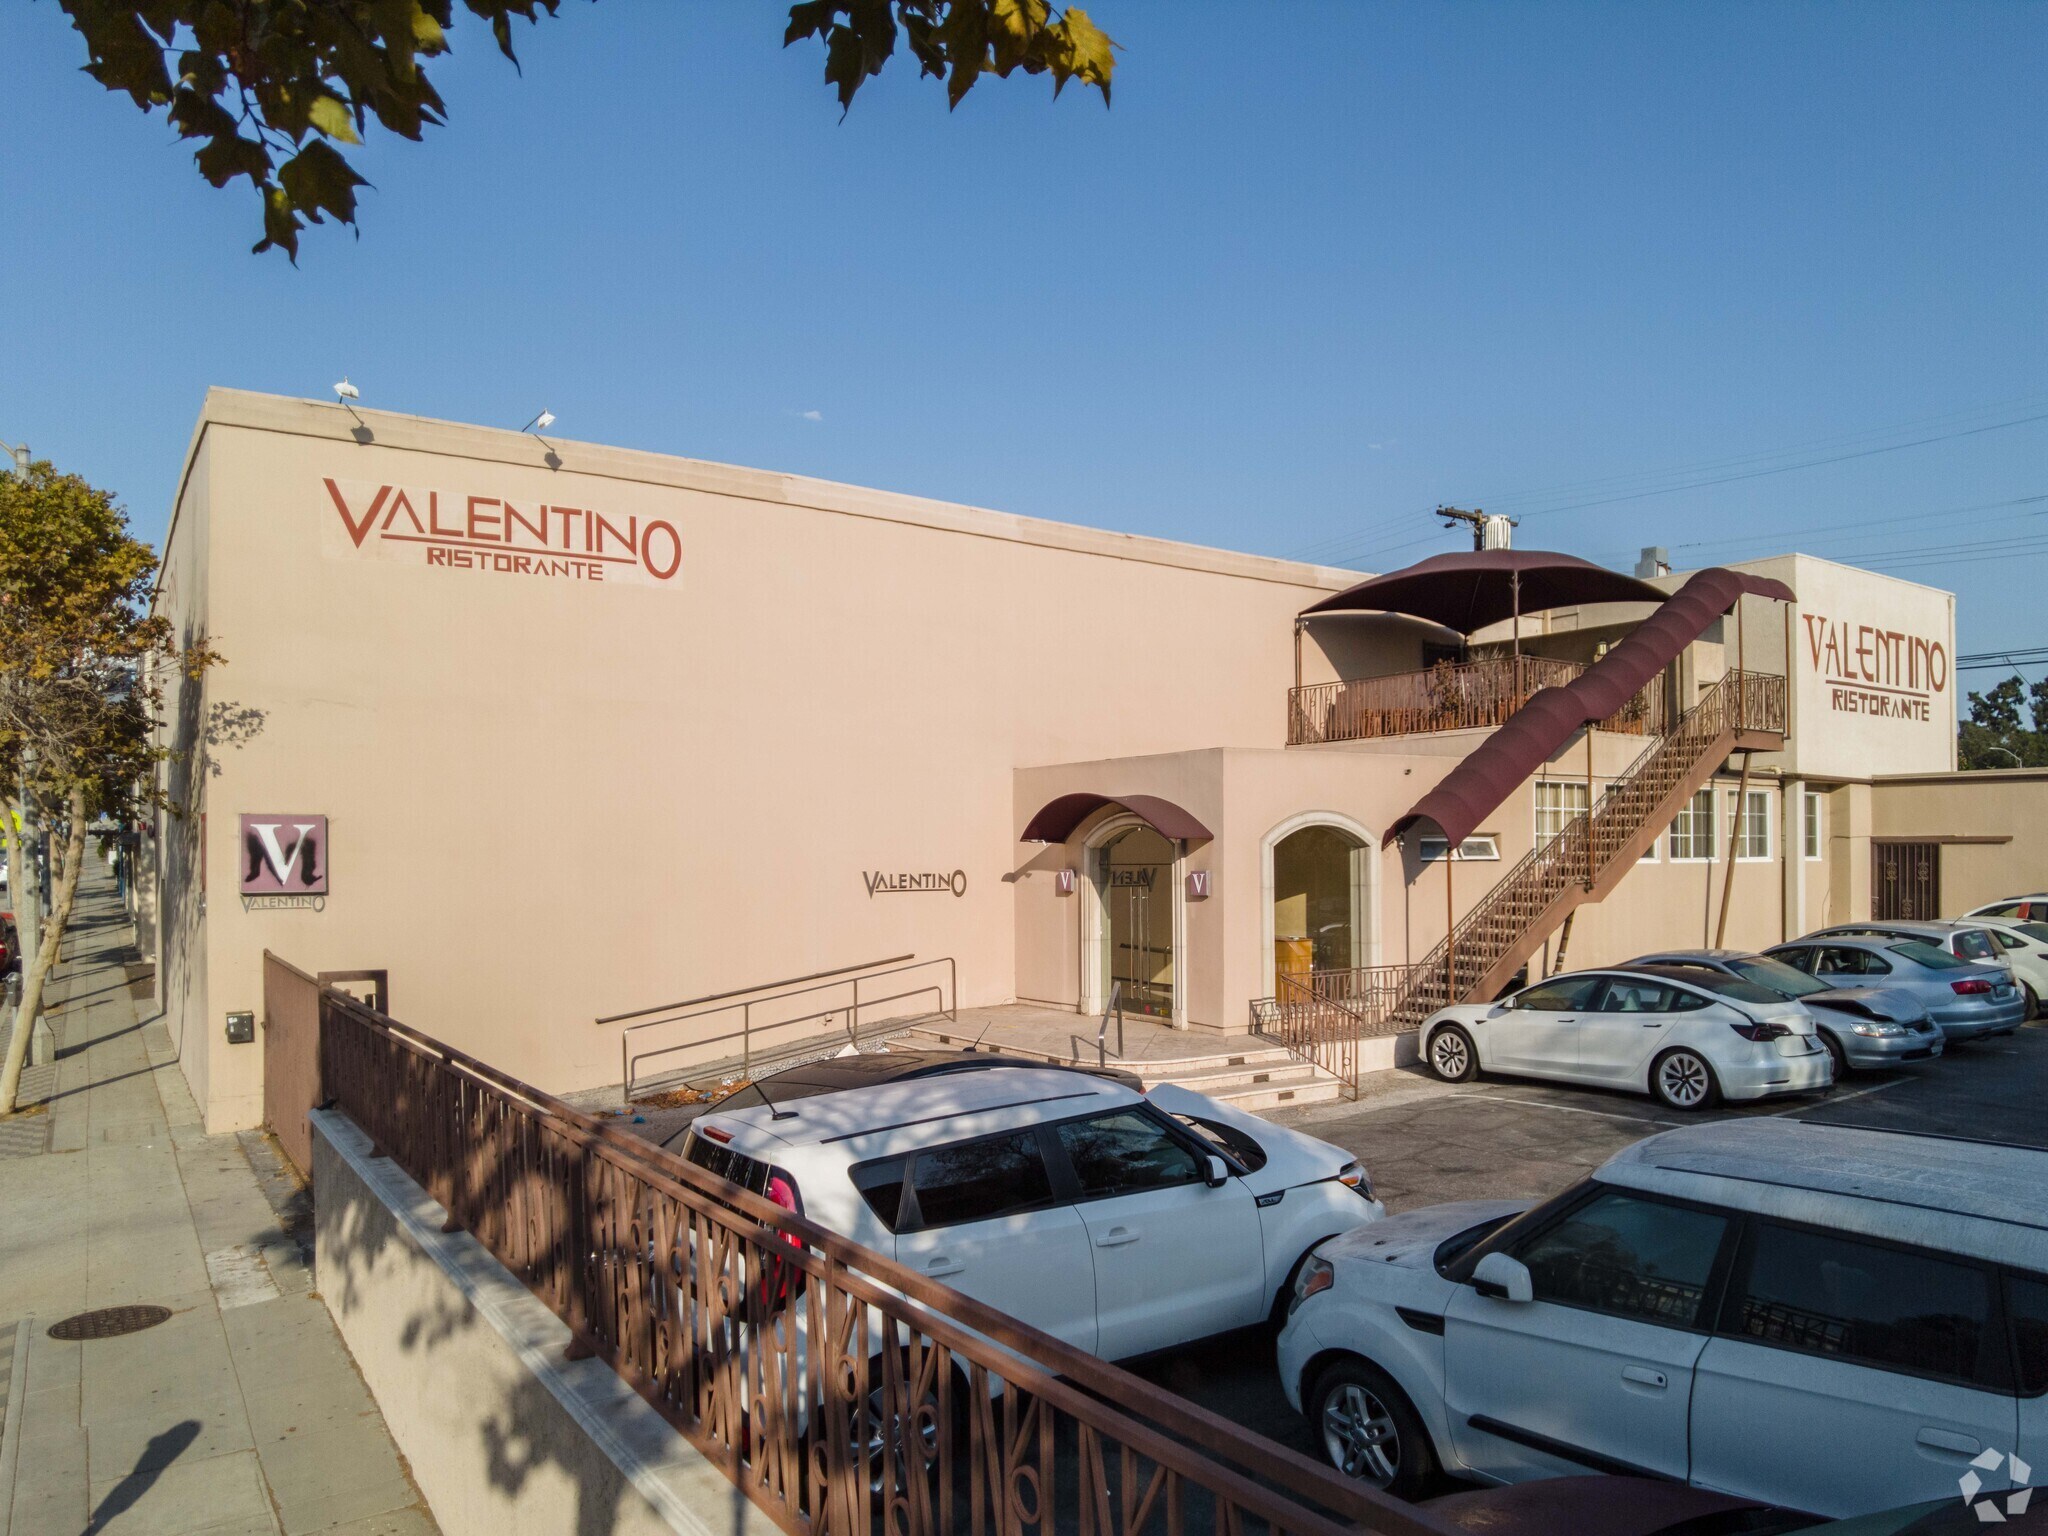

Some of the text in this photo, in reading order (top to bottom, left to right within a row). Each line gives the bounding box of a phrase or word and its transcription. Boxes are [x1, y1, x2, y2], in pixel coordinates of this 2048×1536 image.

[323, 478, 682, 579] VALENTINO
[427, 547, 603, 581] RISTORANTE
[1802, 613, 1946, 692] VALENTINO
[1832, 688, 1930, 722] RISTORANTE
[862, 869, 967, 899] VALENTINO
[1060, 871, 1071, 889] V
[1192, 873, 1206, 894] V
[240, 896, 325, 914] VALENTINO
